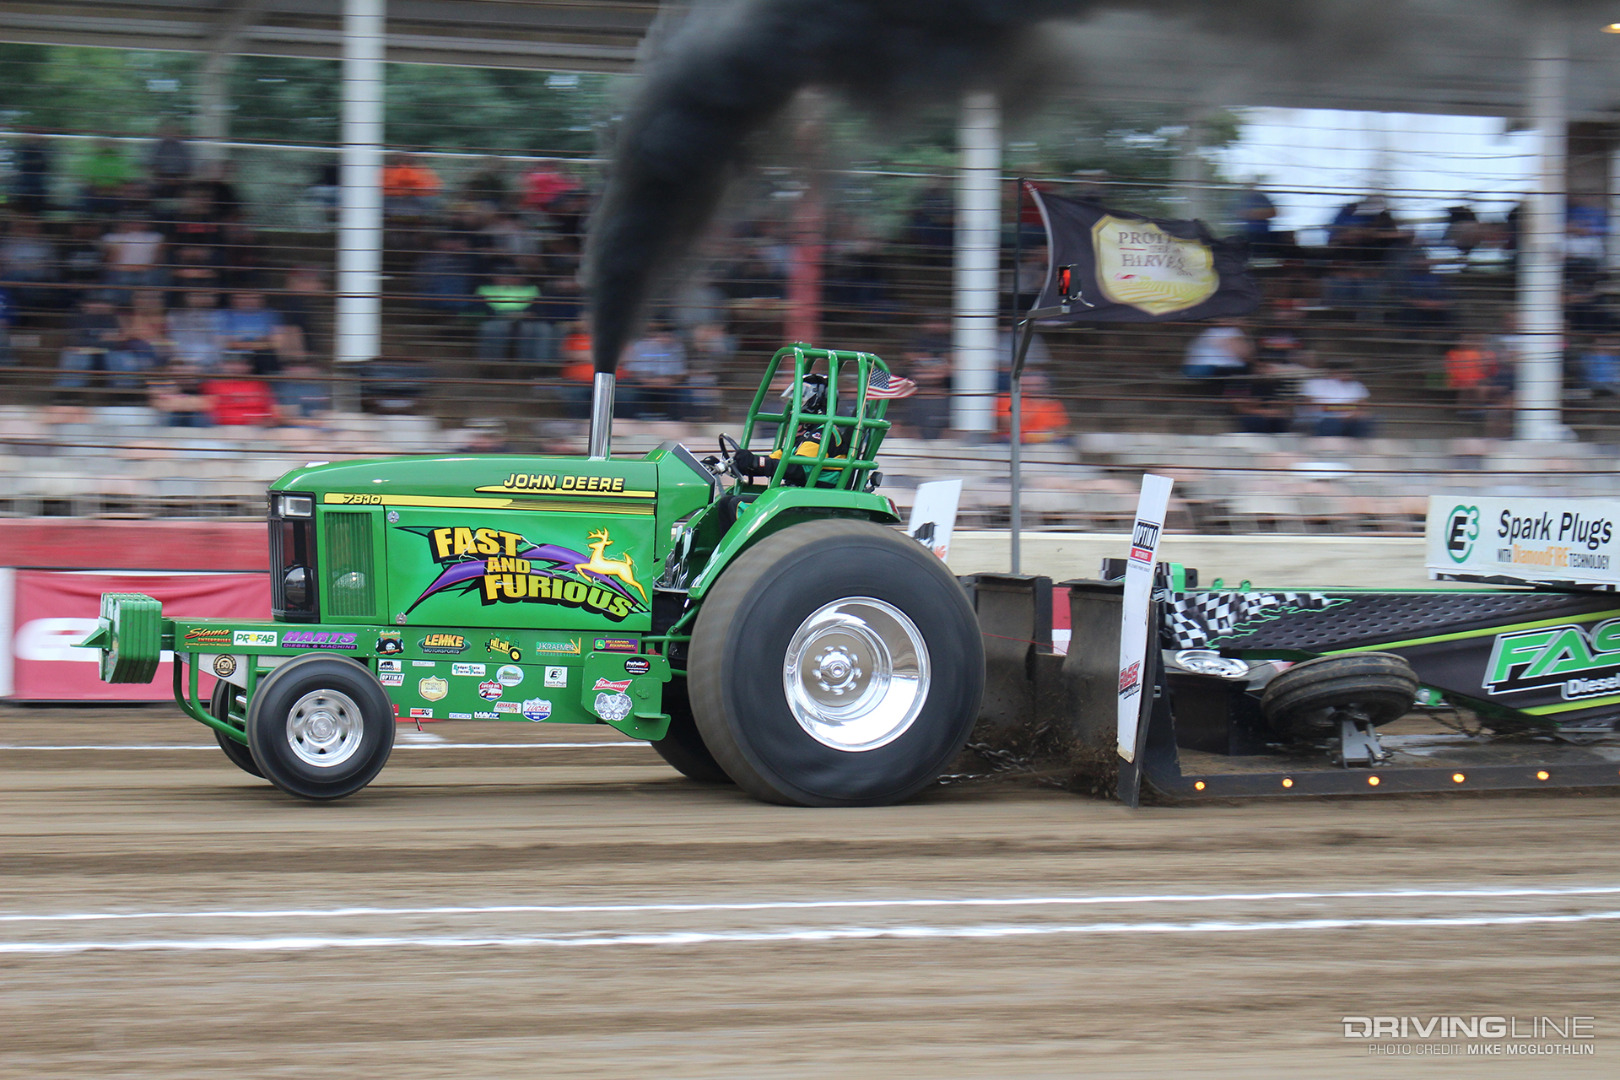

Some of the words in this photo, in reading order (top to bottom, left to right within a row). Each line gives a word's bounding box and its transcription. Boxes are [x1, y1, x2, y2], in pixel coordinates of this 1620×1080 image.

[504, 474, 556, 490] JOHN
[561, 475, 625, 491] DEERE
[343, 494, 382, 505] 7810
[1497, 509, 1554, 545] Spark
[1558, 512, 1613, 550] Plugs
[431, 527, 523, 561] FAST
[487, 557, 531, 574] AND
[482, 574, 634, 620] FURIOUS
[184, 628, 231, 639] Slama
[282, 631, 358, 644] HARTS
[424, 634, 465, 647] LEMKE
[596, 680, 629, 689] Budweiser
